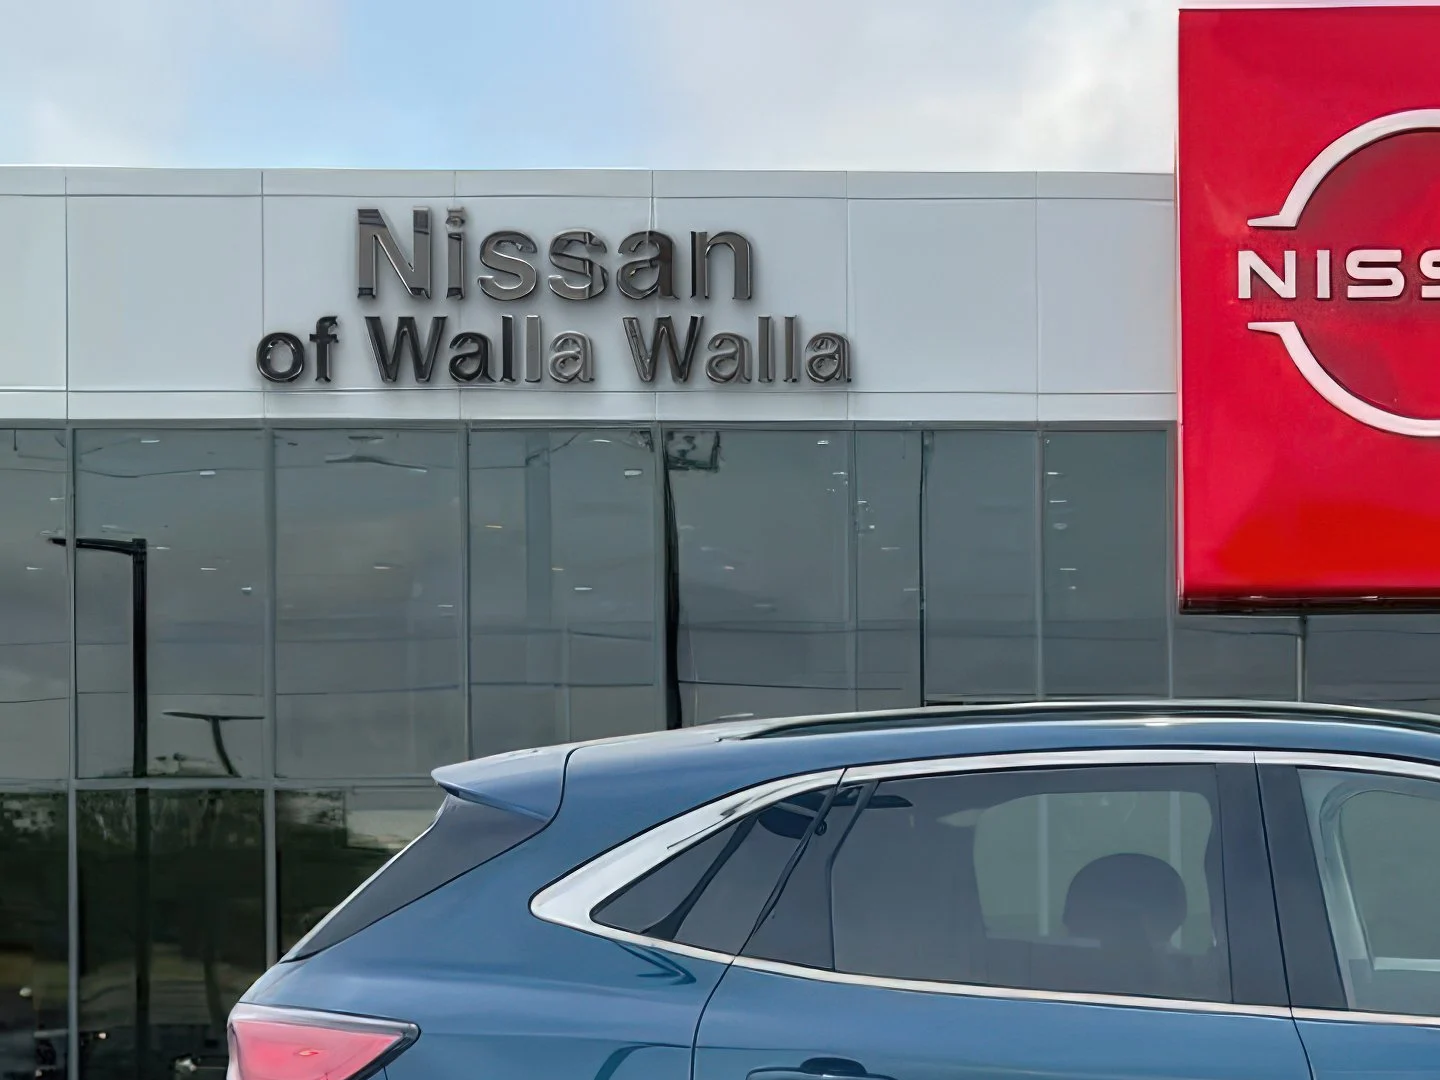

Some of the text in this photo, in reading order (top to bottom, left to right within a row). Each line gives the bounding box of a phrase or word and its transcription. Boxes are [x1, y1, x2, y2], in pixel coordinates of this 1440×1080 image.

[356, 206, 755, 301] Nissan
[255, 314, 853, 384] of Walla Walla
